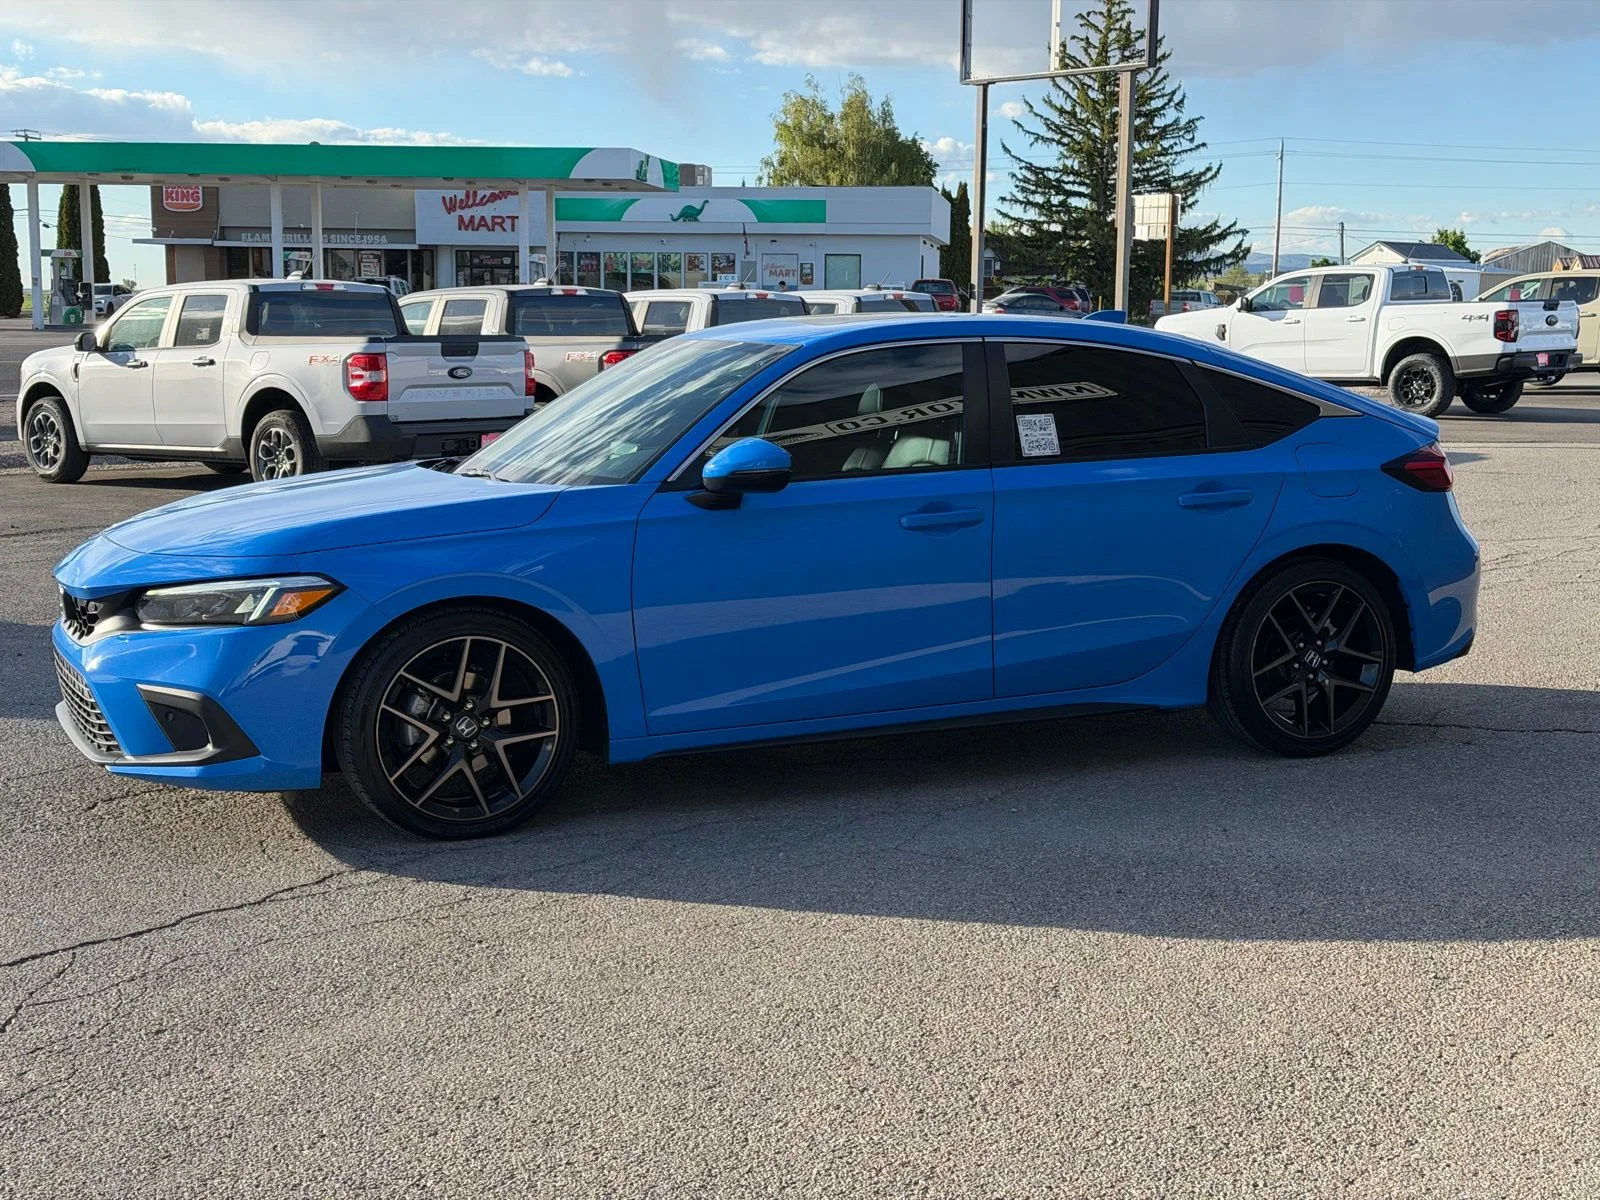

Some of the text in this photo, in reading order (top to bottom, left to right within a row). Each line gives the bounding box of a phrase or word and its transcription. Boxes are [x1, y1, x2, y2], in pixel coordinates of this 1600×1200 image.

[164, 190, 201, 202] KING
[457, 214, 520, 232] MART
[240, 232, 273, 243] FLAM
[330, 234, 361, 244] SINCE
[361, 234, 389, 244] 1954
[769, 268, 797, 278] MART
[308, 354, 342, 365] FX4
[565, 352, 598, 361] FX4
